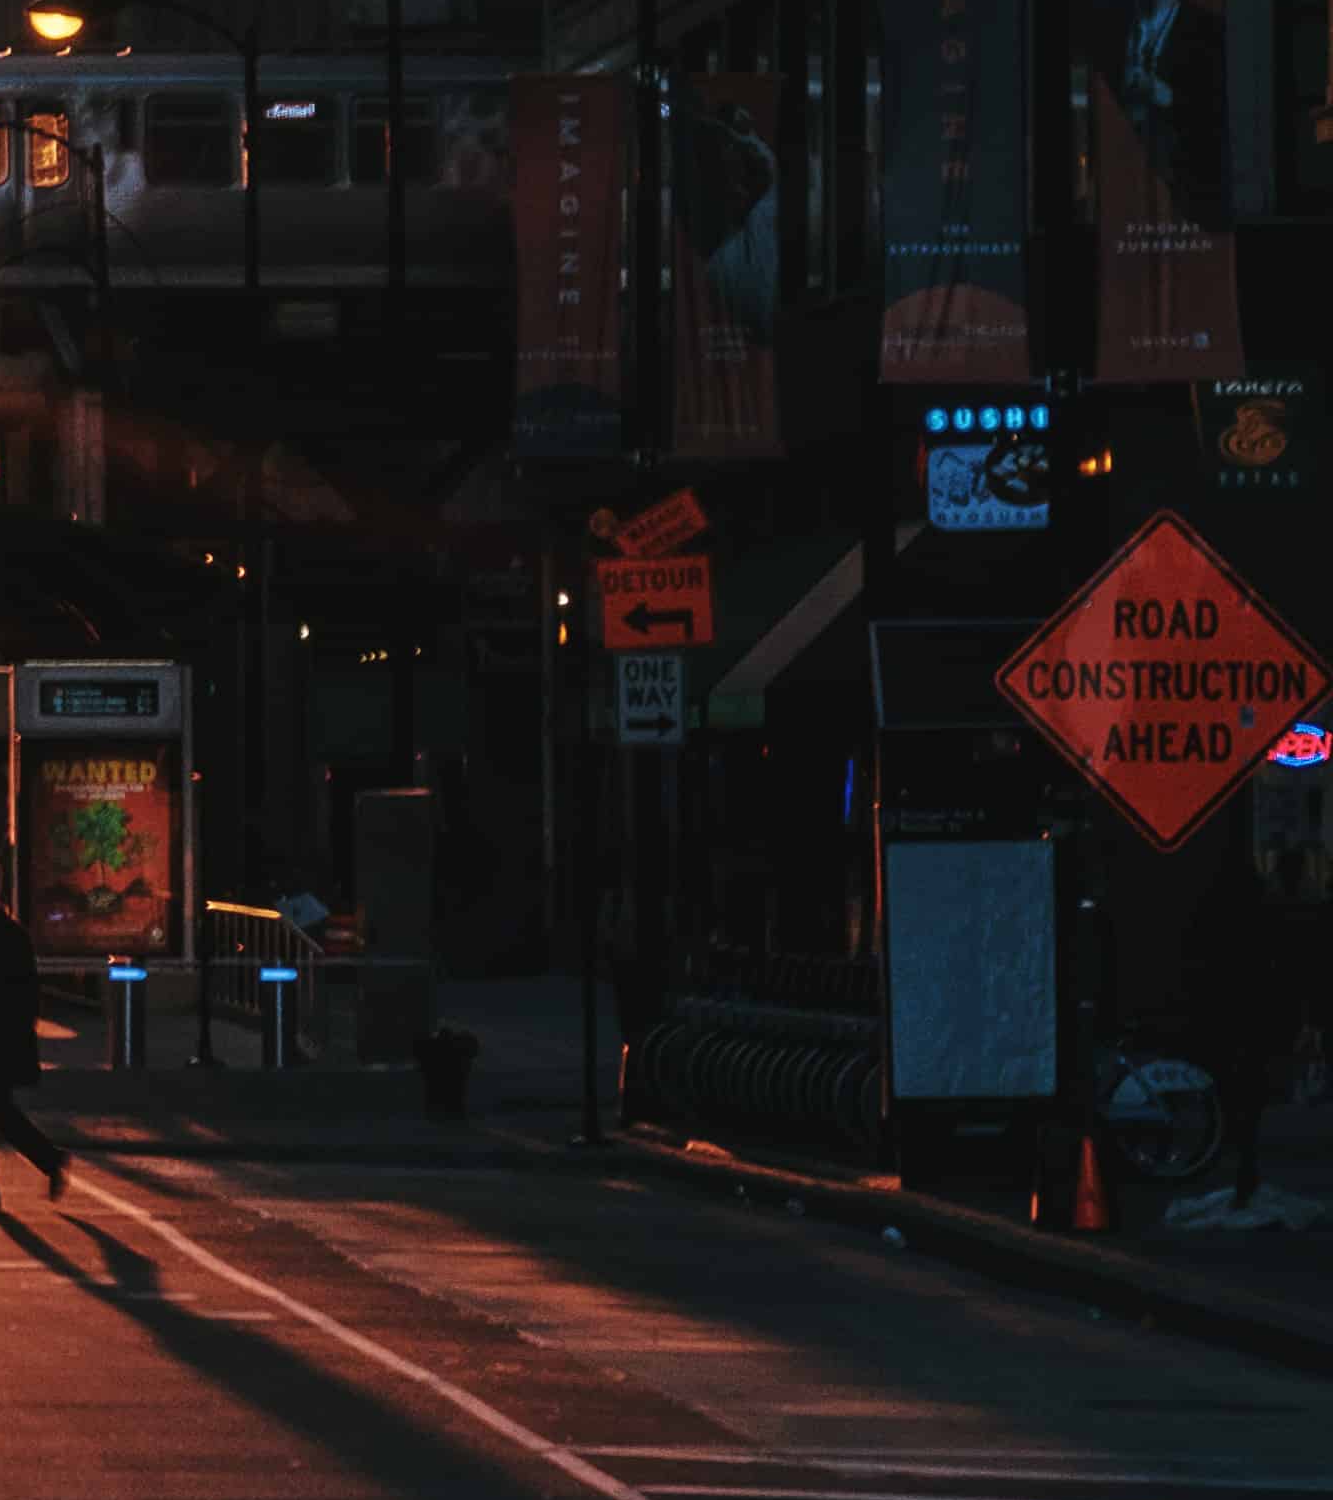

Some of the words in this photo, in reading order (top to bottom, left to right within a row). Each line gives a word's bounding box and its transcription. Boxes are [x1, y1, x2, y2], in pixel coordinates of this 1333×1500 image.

[558, 93, 582, 305] IMAGINE
[926, 403, 1050, 432] SUSHI
[604, 567, 703, 593] DETOUR
[1113, 600, 1219, 640] ROAD
[624, 660, 676, 682] ONE
[1026, 659, 1307, 701] CONSTRUCTION
[625, 686, 677, 706] WAY
[1102, 722, 1232, 763] AHEAD
[41, 759, 159, 784] WANTED
